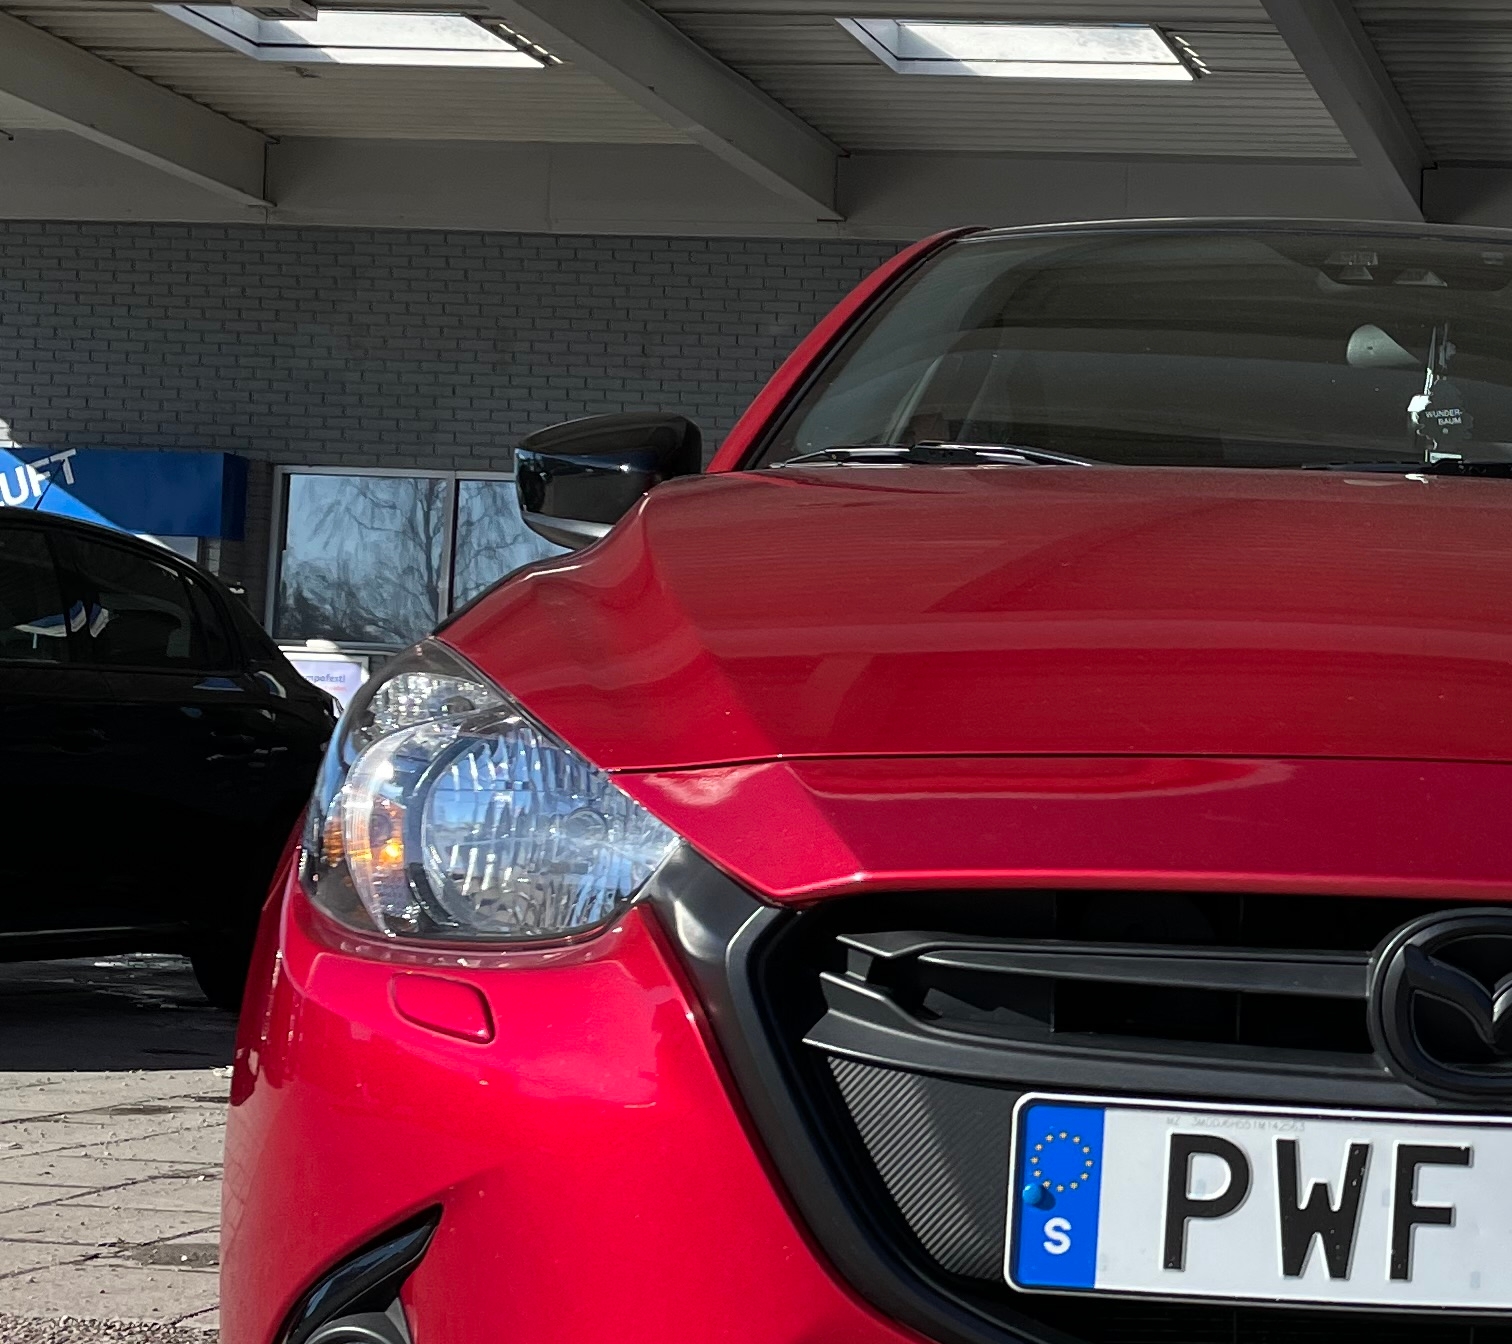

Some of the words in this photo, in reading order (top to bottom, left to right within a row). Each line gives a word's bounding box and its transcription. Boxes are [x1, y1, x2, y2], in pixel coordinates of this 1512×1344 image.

[1425, 408, 1463, 418] WUNDER-
[1438, 417, 1462, 426] BAUM
[0, 448, 77, 506] UFT
[1162, 1132, 1471, 1282] PWF
[1043, 1217, 1072, 1255] S
